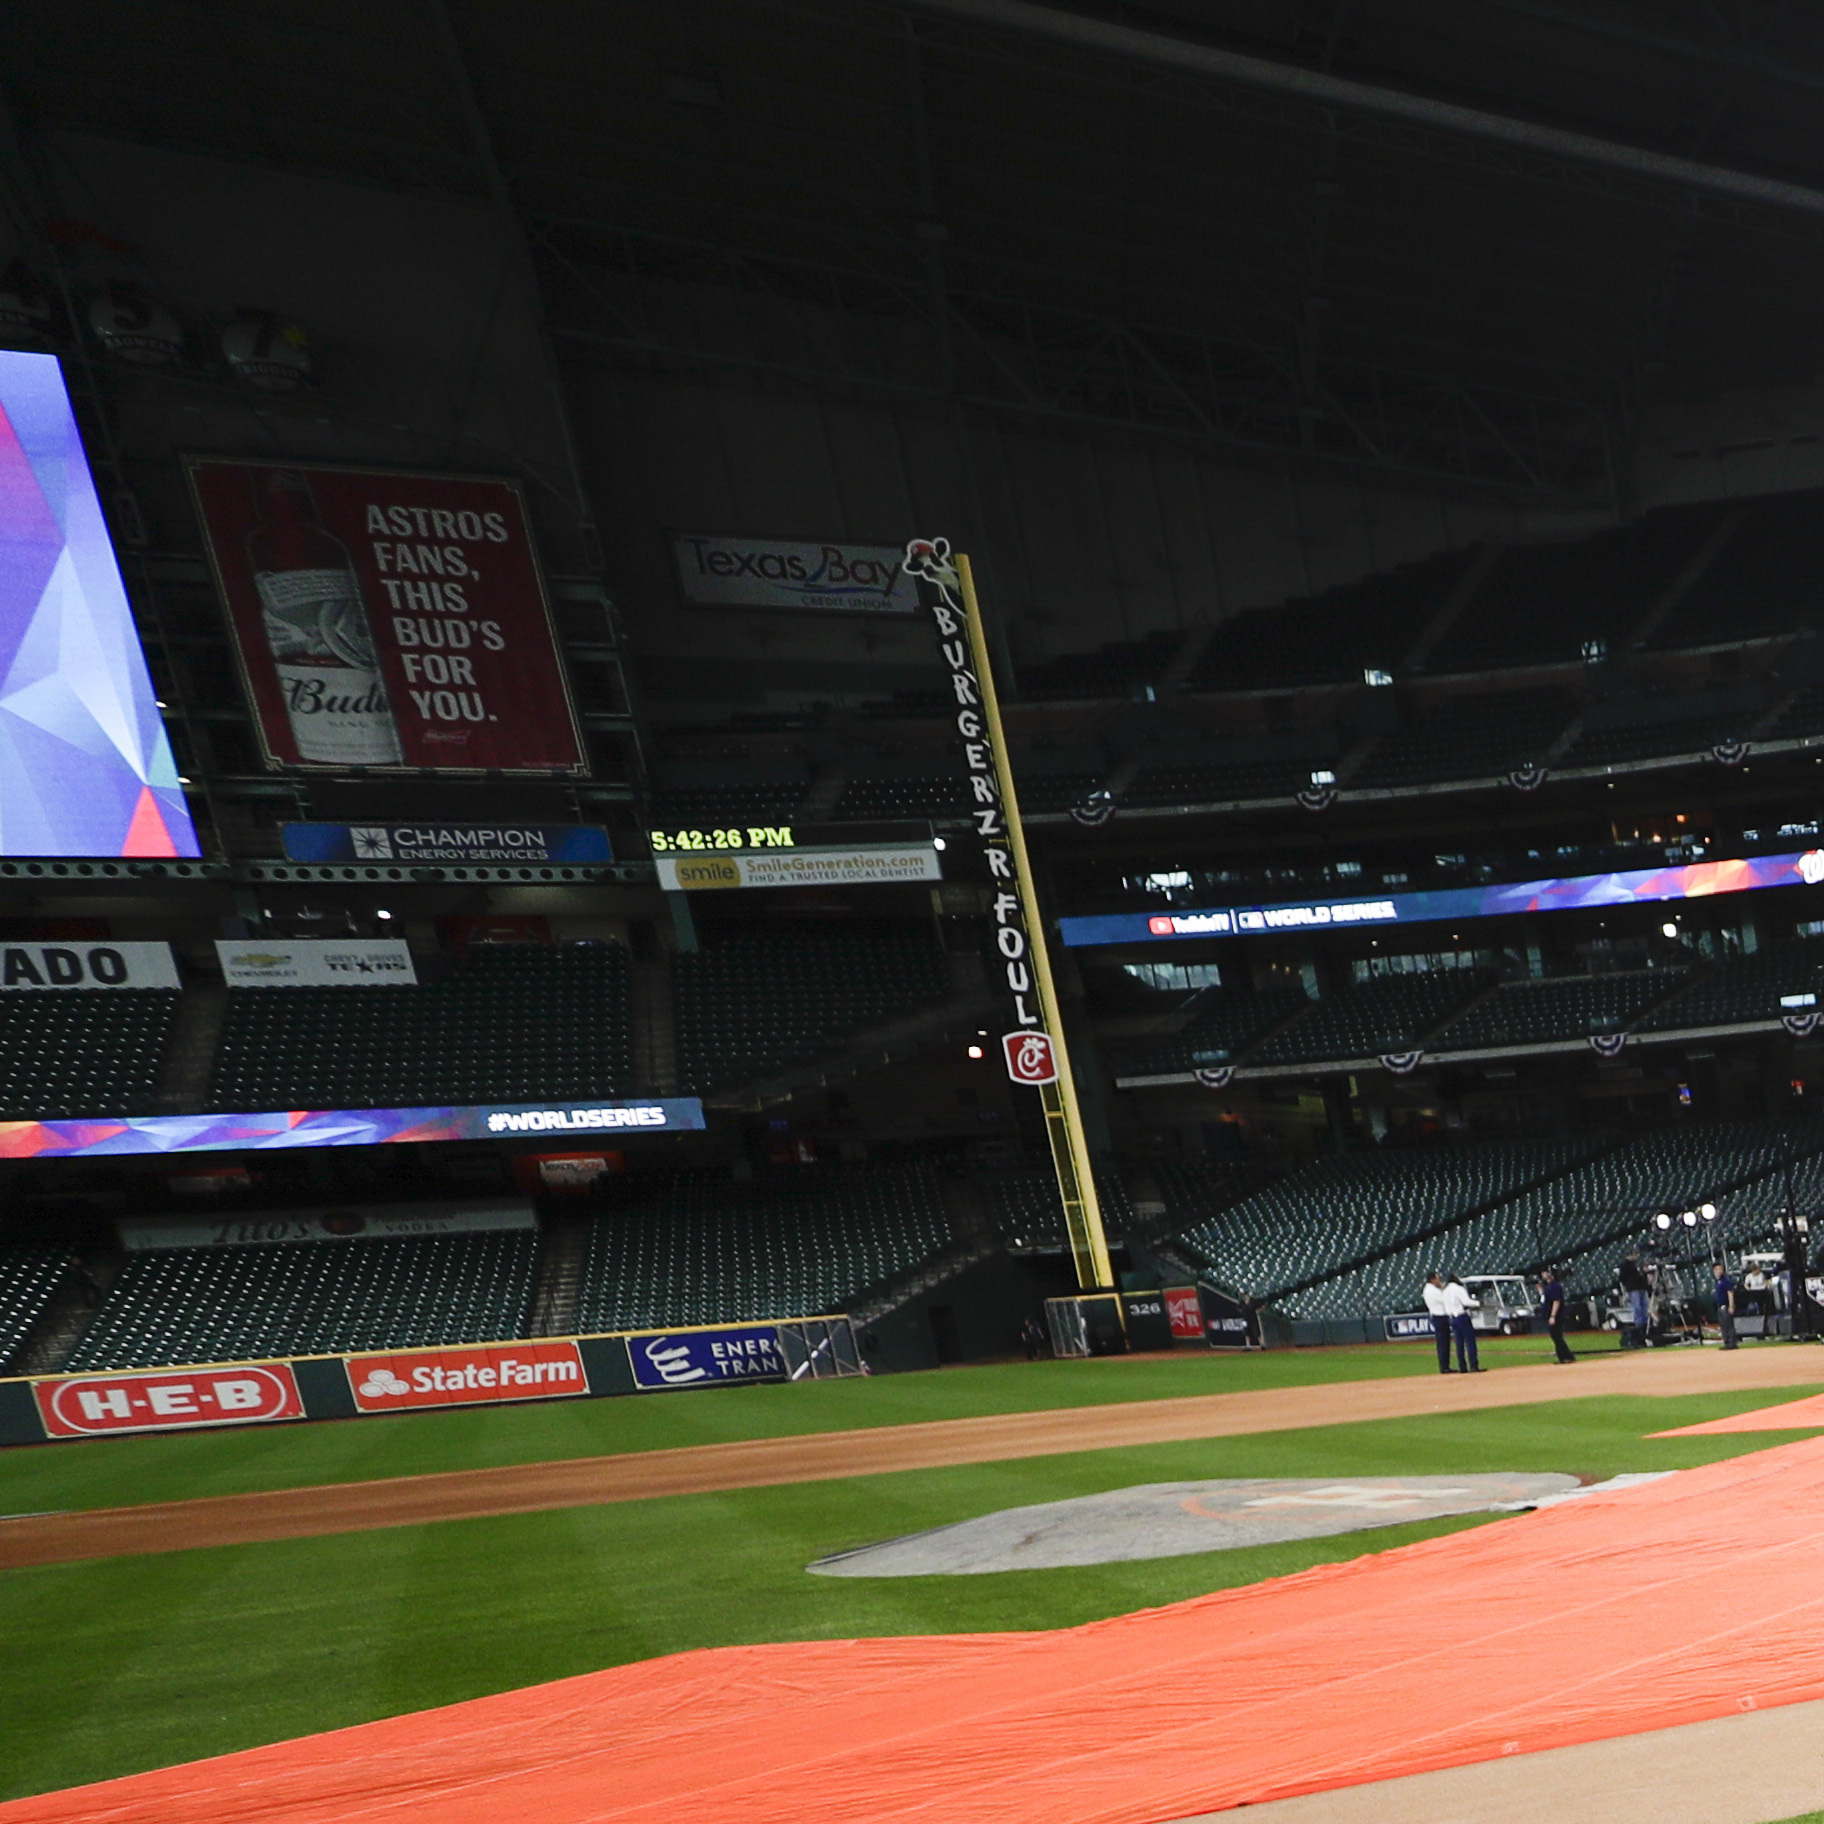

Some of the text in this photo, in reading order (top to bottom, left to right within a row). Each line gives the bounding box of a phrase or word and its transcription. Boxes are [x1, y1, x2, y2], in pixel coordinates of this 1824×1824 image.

[366, 504, 509, 542] ASTROS
[373, 542, 481, 582] FANS,
[685, 538, 902, 598] Texas Bay
[379, 578, 469, 613] THIS
[392, 616, 506, 651] BUD'S
[400, 653, 477, 686] FOR
[408, 689, 498, 722] YOU.
[393, 828, 546, 847] CHAMPION
[650, 826, 795, 851] 5:42:26 PM
[398, 848, 549, 860] ENERGY SERVICES
[746, 855, 925, 873] SmileGeneration.com
[680, 864, 735, 881] smile
[791, 870, 839, 881] TRUSTED
[841, 868, 877, 878] LOCAL
[1264, 906, 1331, 928] WORLD
[993, 891, 1038, 1026] FOUL
[487, 1106, 667, 1134] #WORLDSERIES
[1130, 1302, 1161, 1316] 326
[711, 1338, 782, 1359] ENER
[716, 1356, 780, 1377] TRAN
[77, 1379, 264, 1422] H-E-B
